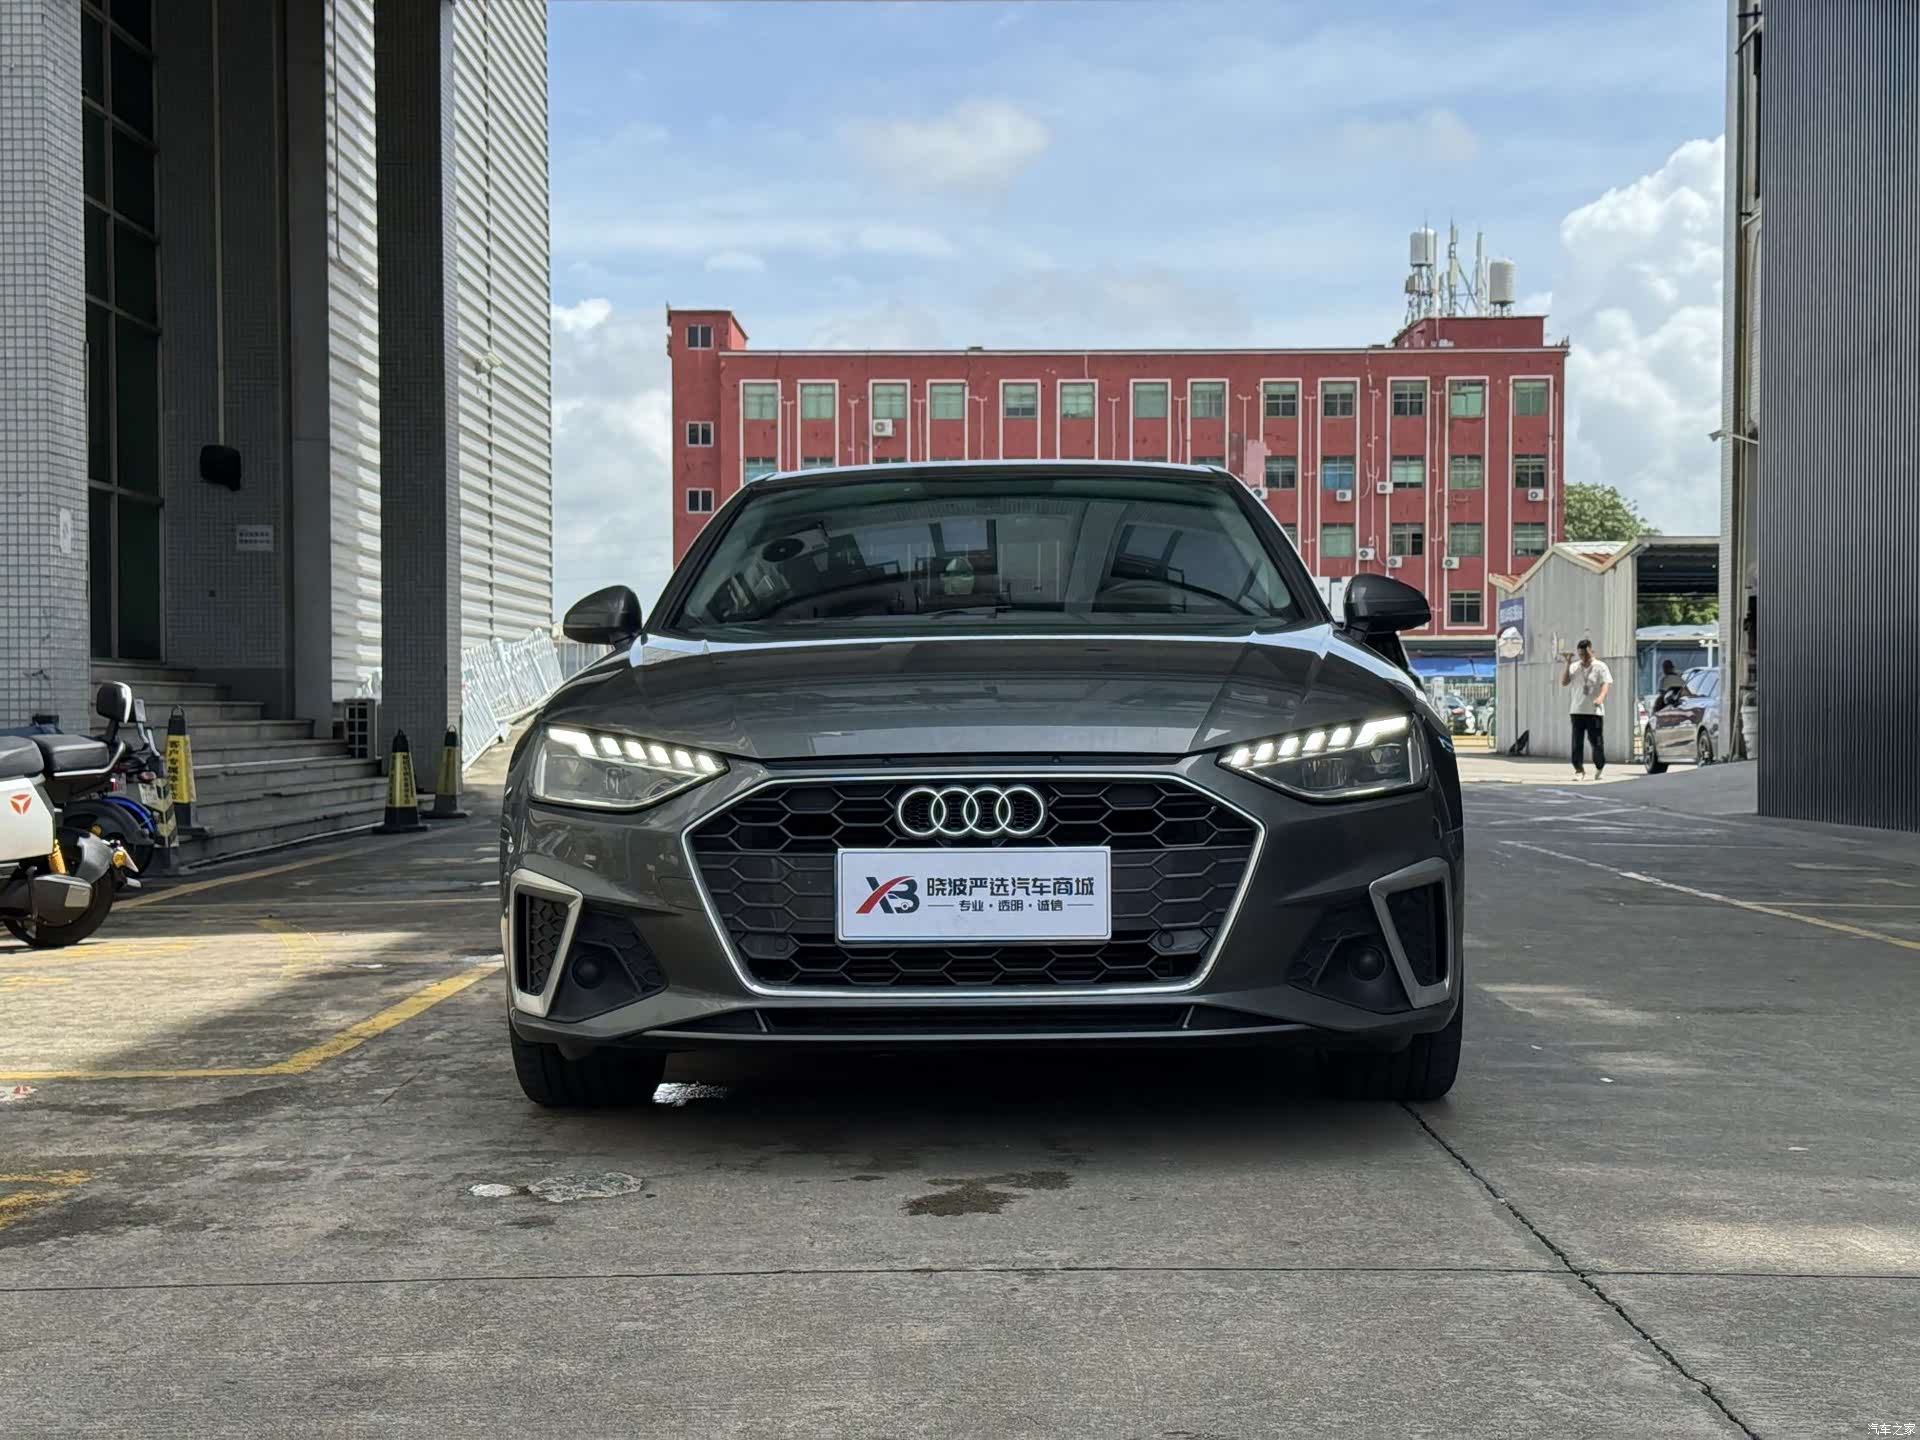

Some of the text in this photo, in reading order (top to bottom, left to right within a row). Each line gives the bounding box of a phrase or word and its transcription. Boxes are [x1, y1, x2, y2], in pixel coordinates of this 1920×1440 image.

[927, 877, 1094, 896] 晓波严选汽车商城
